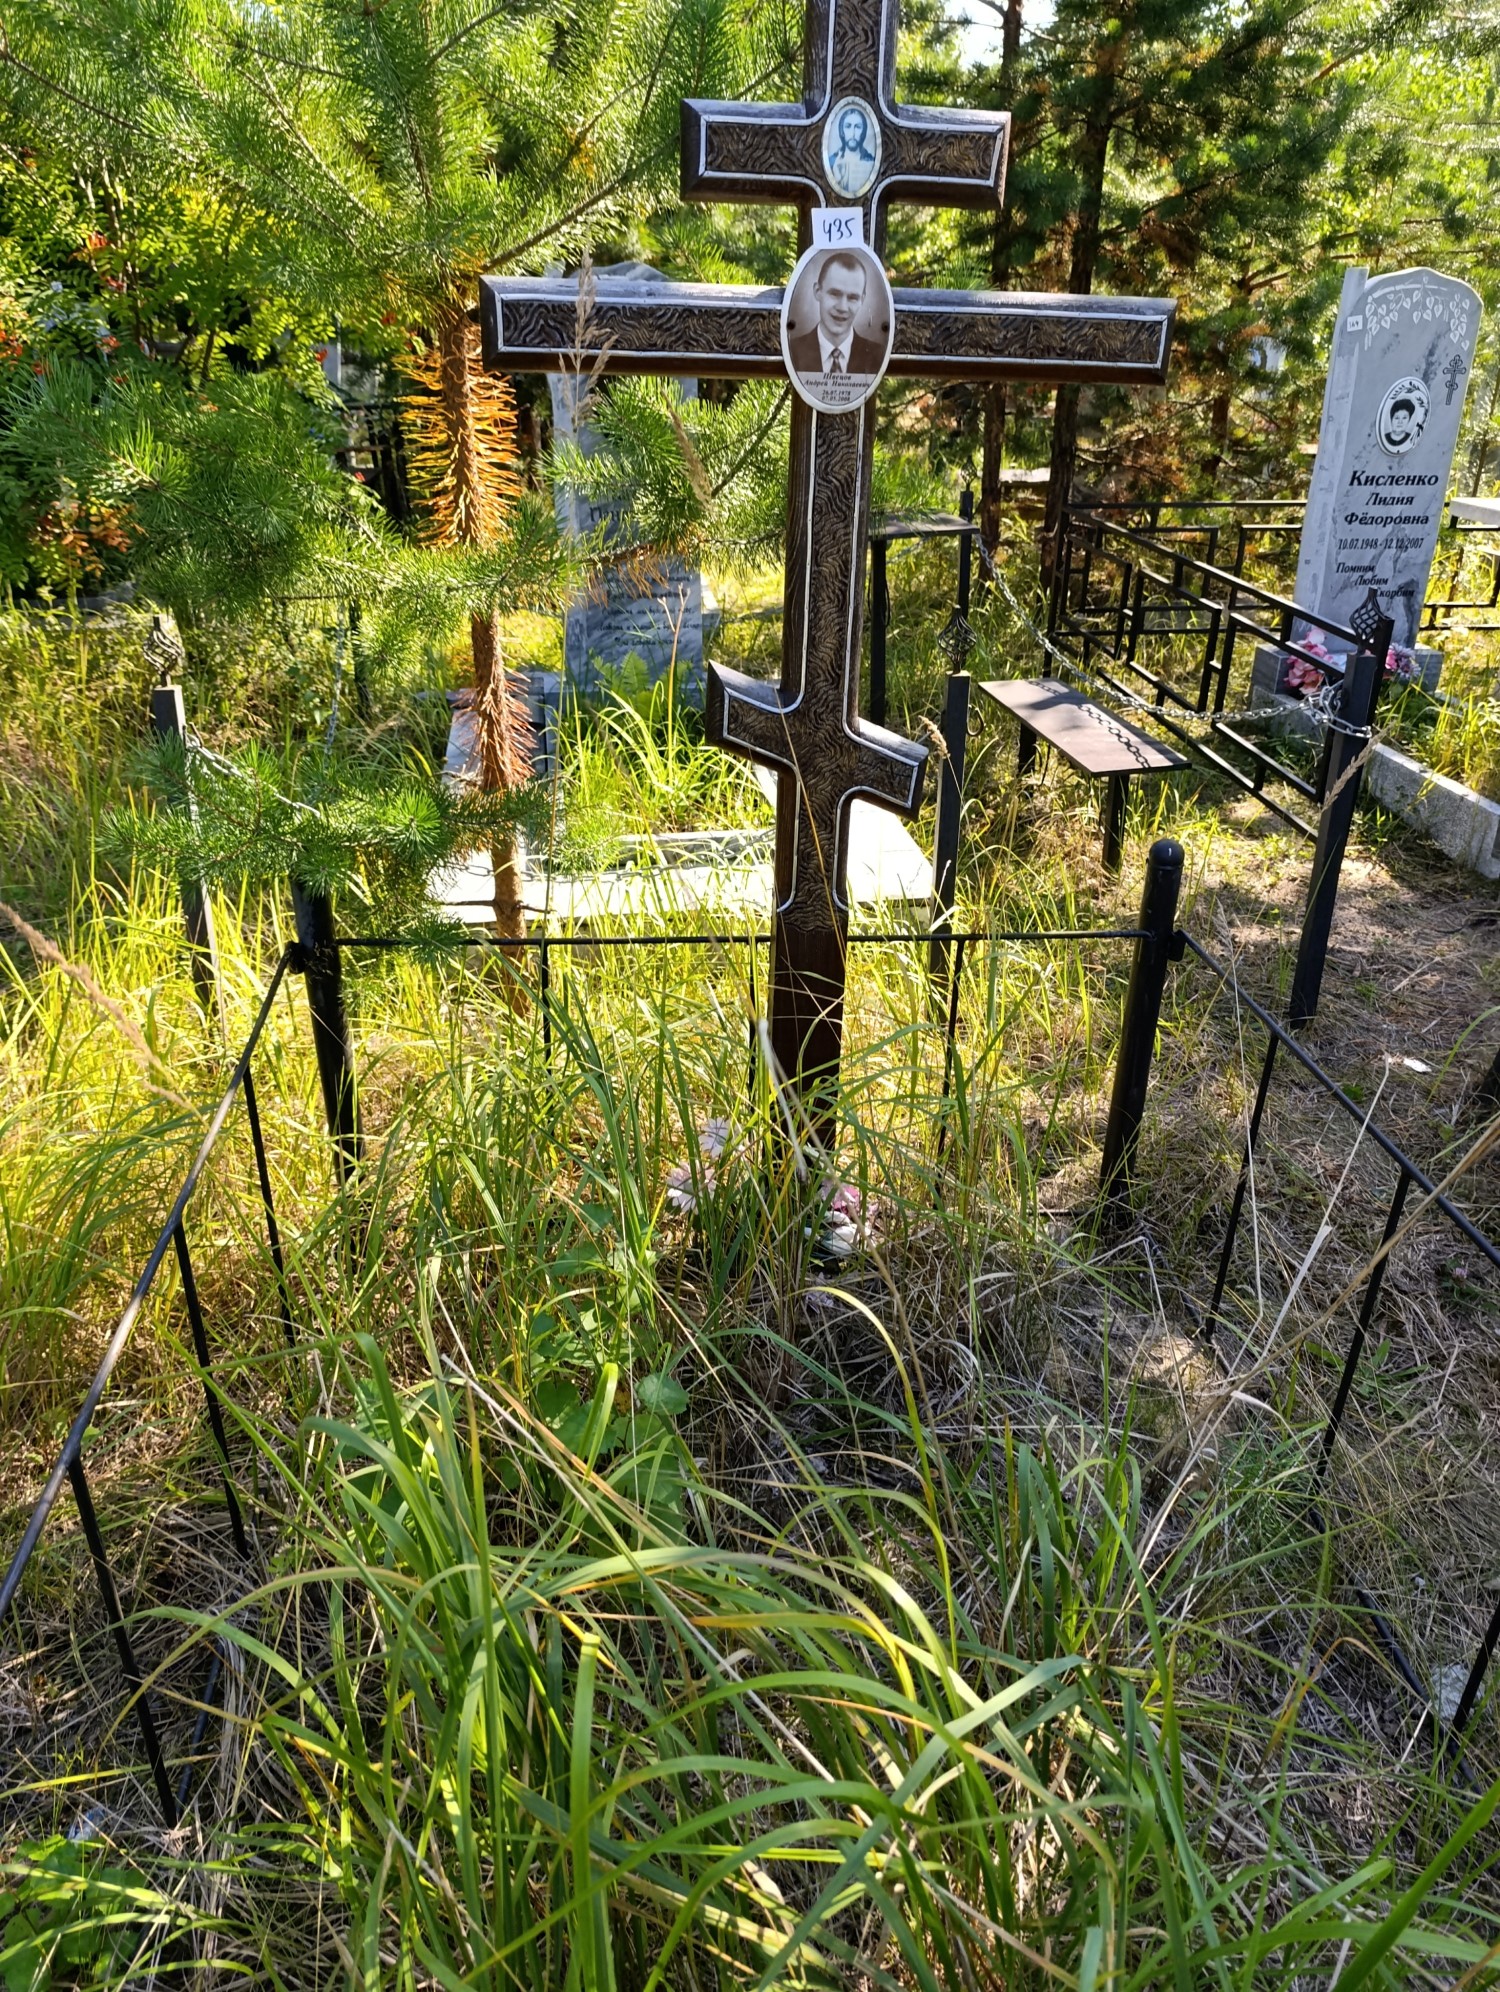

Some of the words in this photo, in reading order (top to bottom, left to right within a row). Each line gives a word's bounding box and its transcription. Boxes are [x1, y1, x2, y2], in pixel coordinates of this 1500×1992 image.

[823, 217, 855, 243] 435
[804, 380, 828, 388] Андрей
[1348, 470, 1439, 486] Кисленко
[1365, 492, 1415, 506] Лидия
[1344, 512, 1430, 528] Фёдоровна
[1338, 538, 1379, 550] 10.07.1948
[1384, 537, 1425, 549] 12.12.2007
[1336, 562, 1375, 573] Помним
[1354, 575, 1389, 586] Любим
